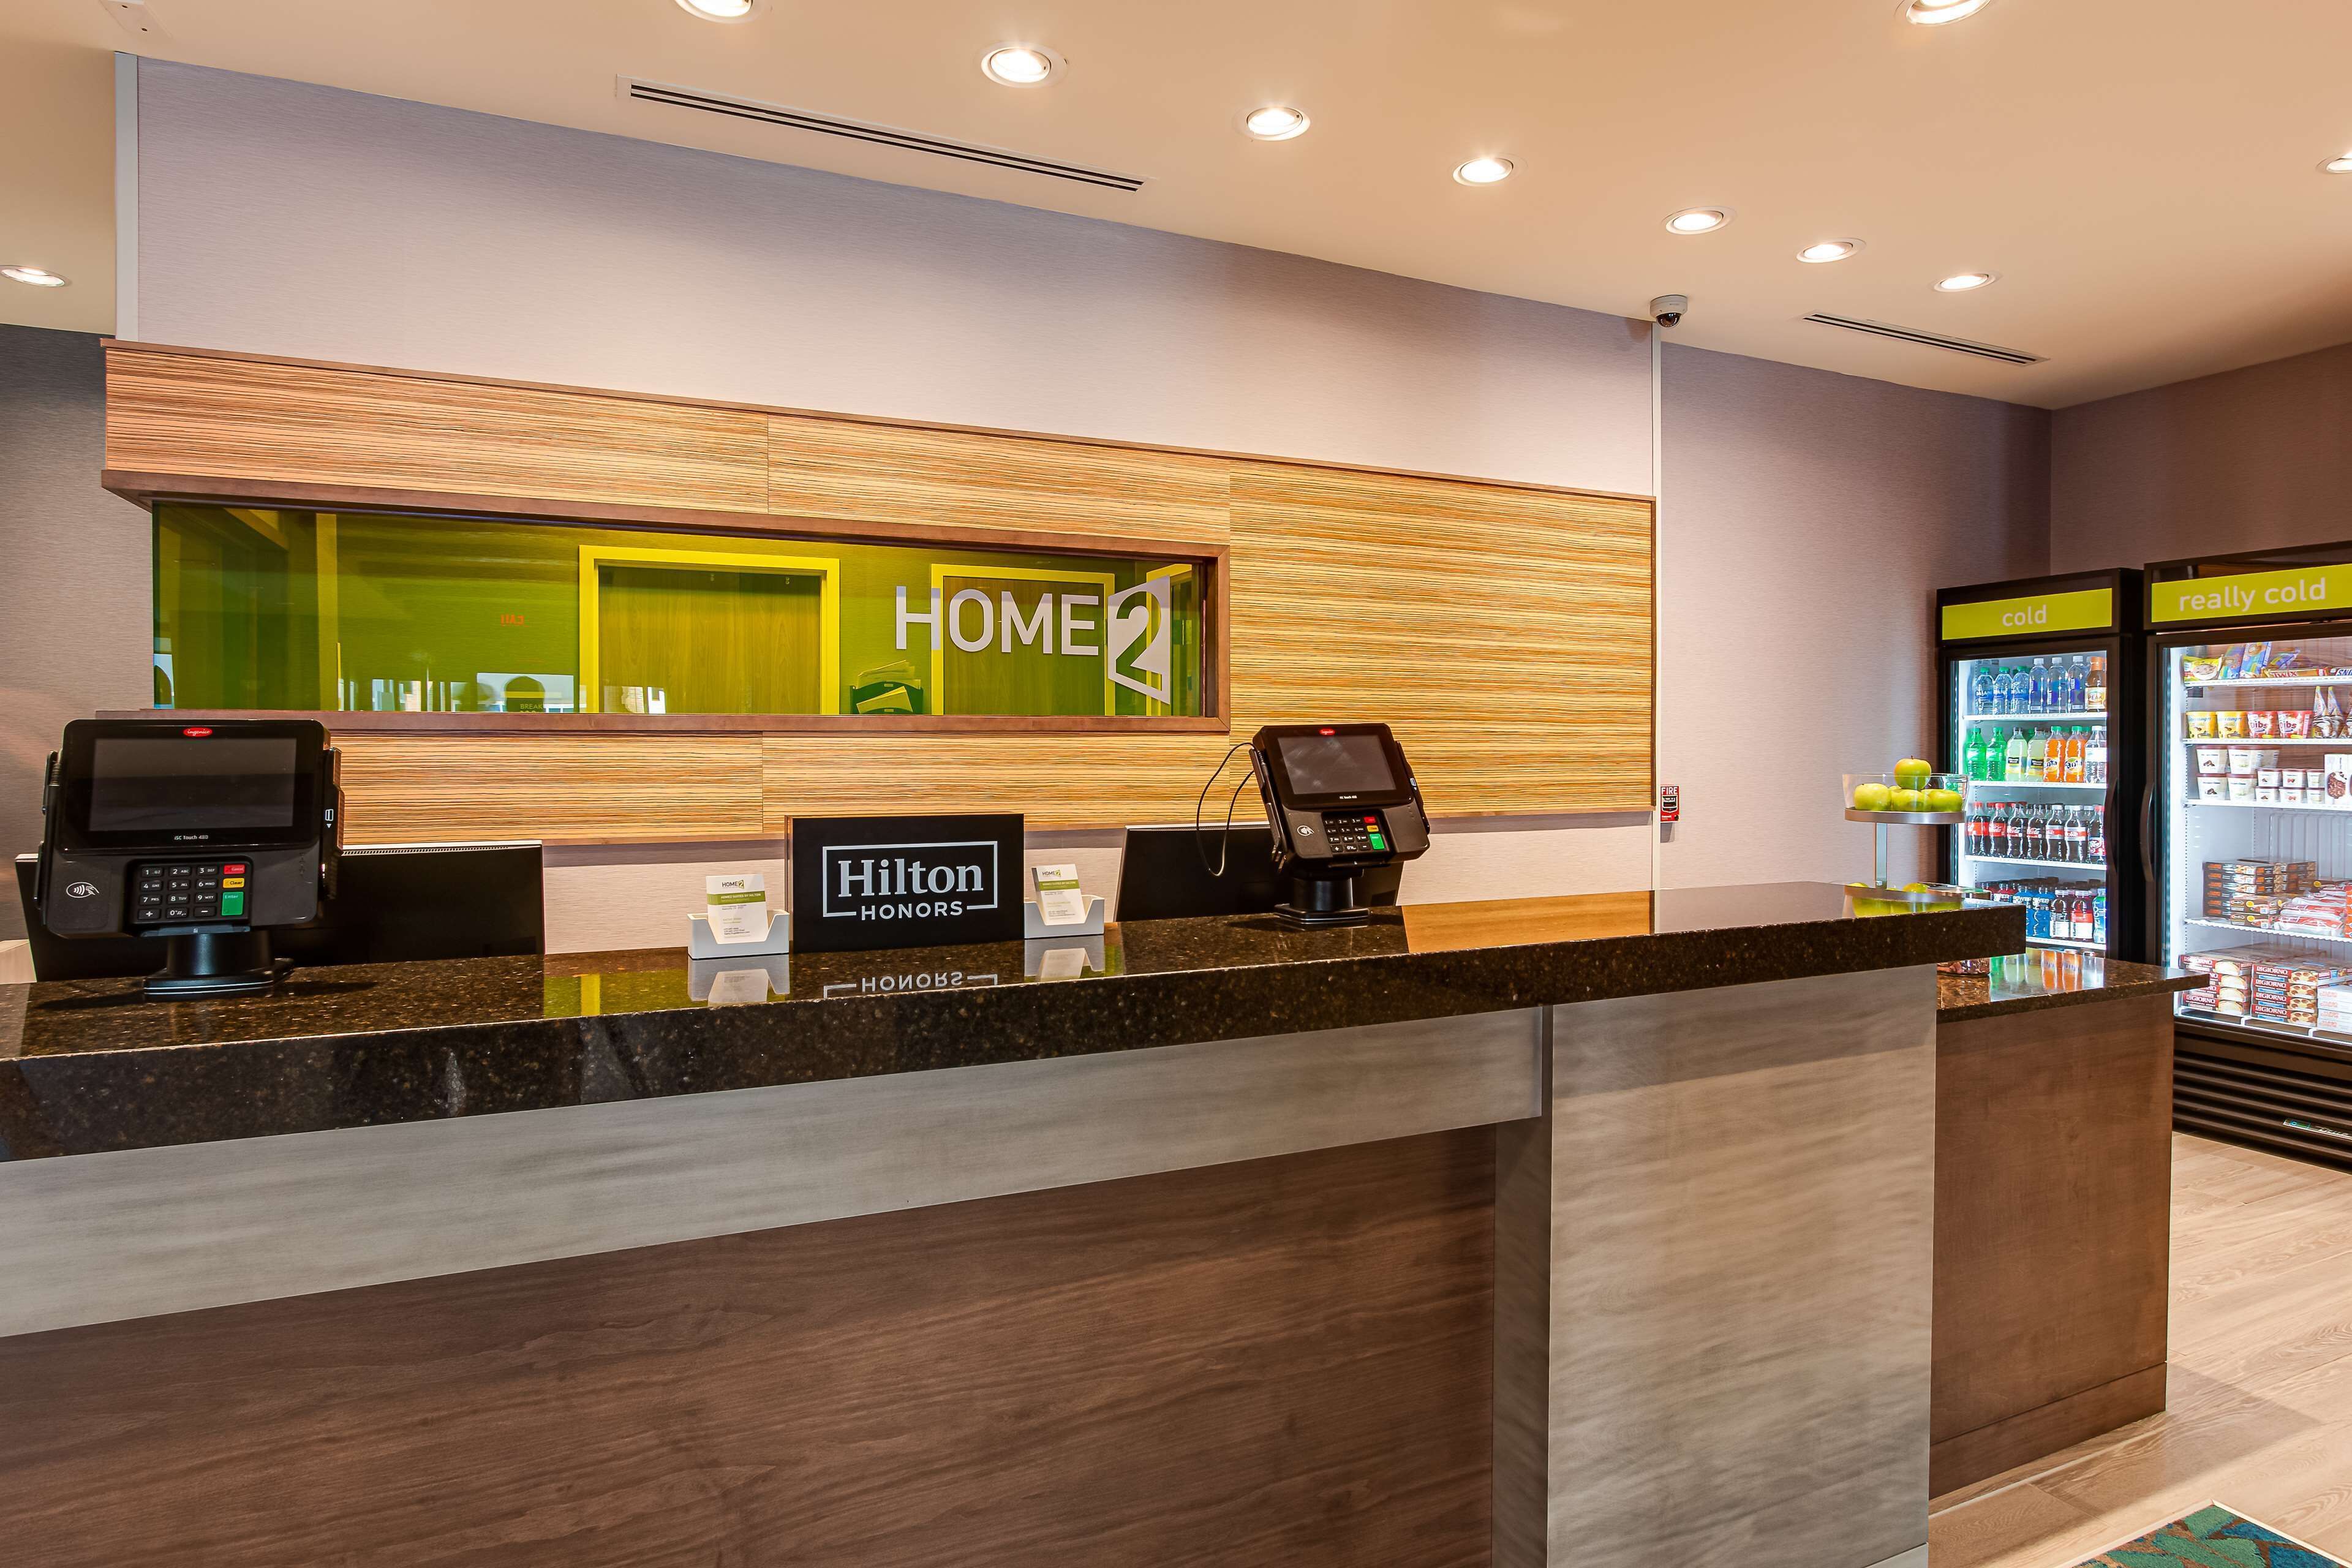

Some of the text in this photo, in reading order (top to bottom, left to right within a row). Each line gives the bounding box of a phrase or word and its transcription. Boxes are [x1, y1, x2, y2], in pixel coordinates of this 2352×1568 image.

[2179, 577, 2326, 612] really cold
[2002, 605, 2047, 627] cold
[1661, 786, 1678, 795] FIRE
[838, 858, 984, 897] Hilton
[861, 901, 962, 921] HONORS
